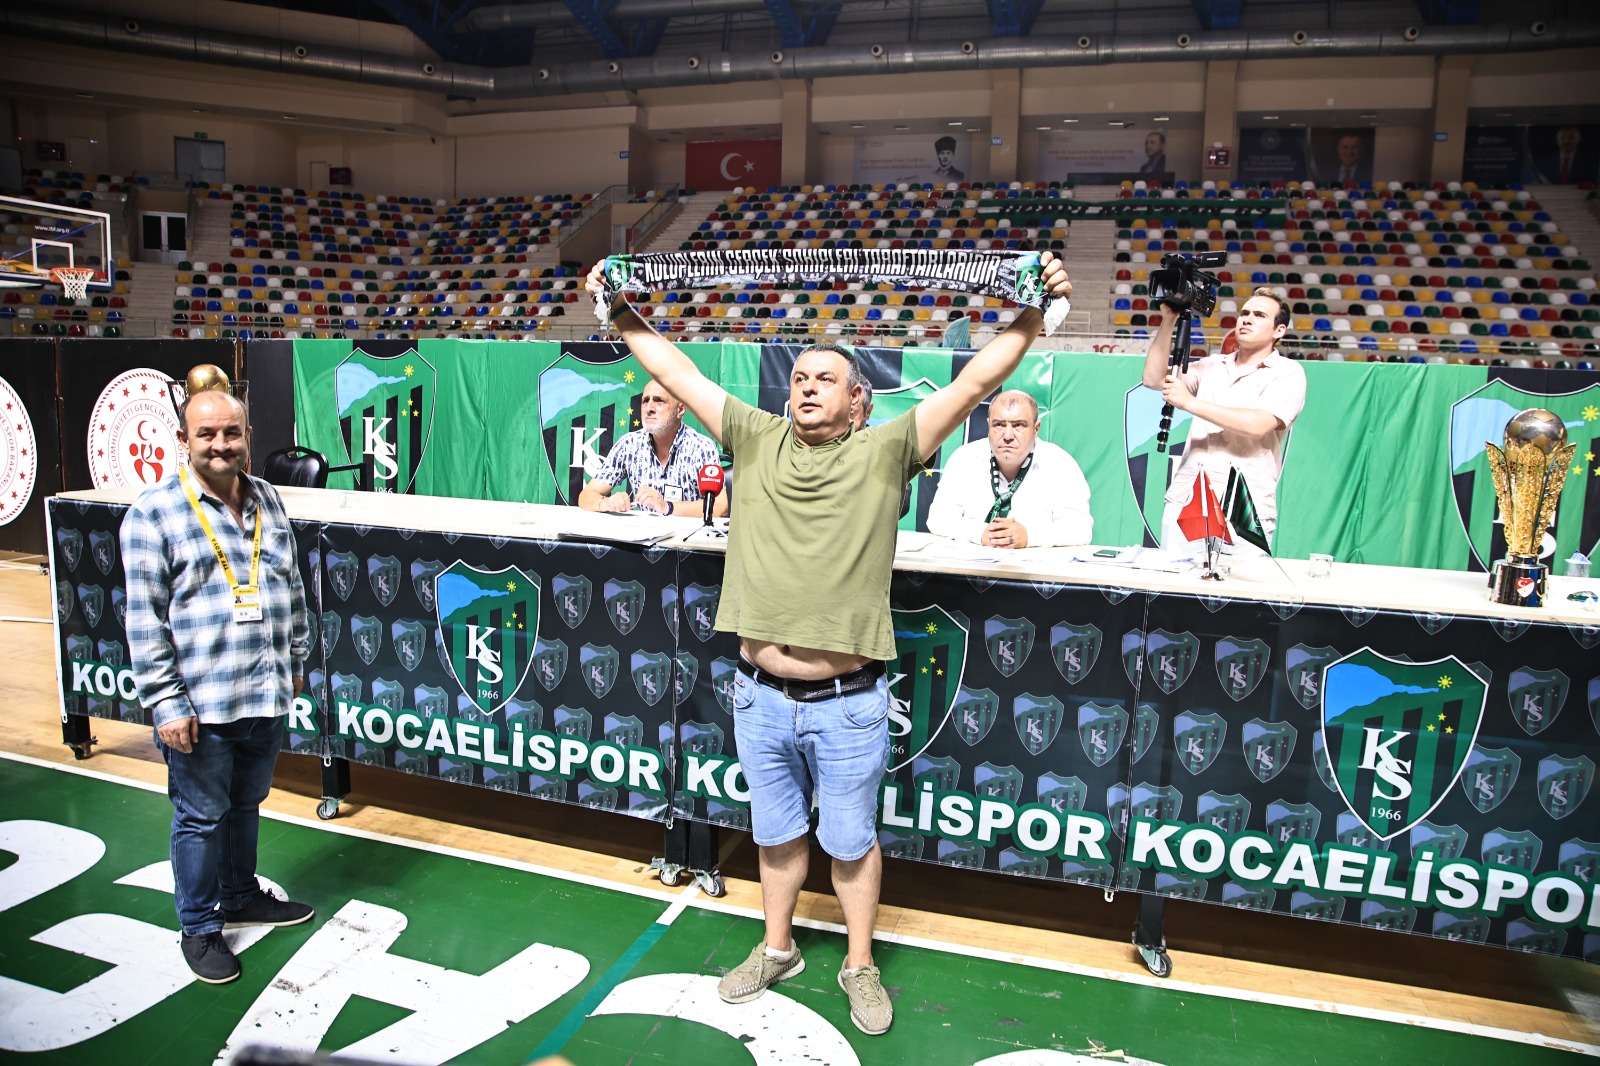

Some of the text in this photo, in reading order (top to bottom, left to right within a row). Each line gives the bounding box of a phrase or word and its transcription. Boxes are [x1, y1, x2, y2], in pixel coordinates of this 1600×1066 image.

[363, 417, 398, 480] KS
[466, 624, 503, 683] KS
[478, 690, 498, 700] 1966
[338, 702, 661, 791] KOCAELİSPOR
[1358, 728, 1412, 800] KS
[1370, 806, 1402, 821] 1966
